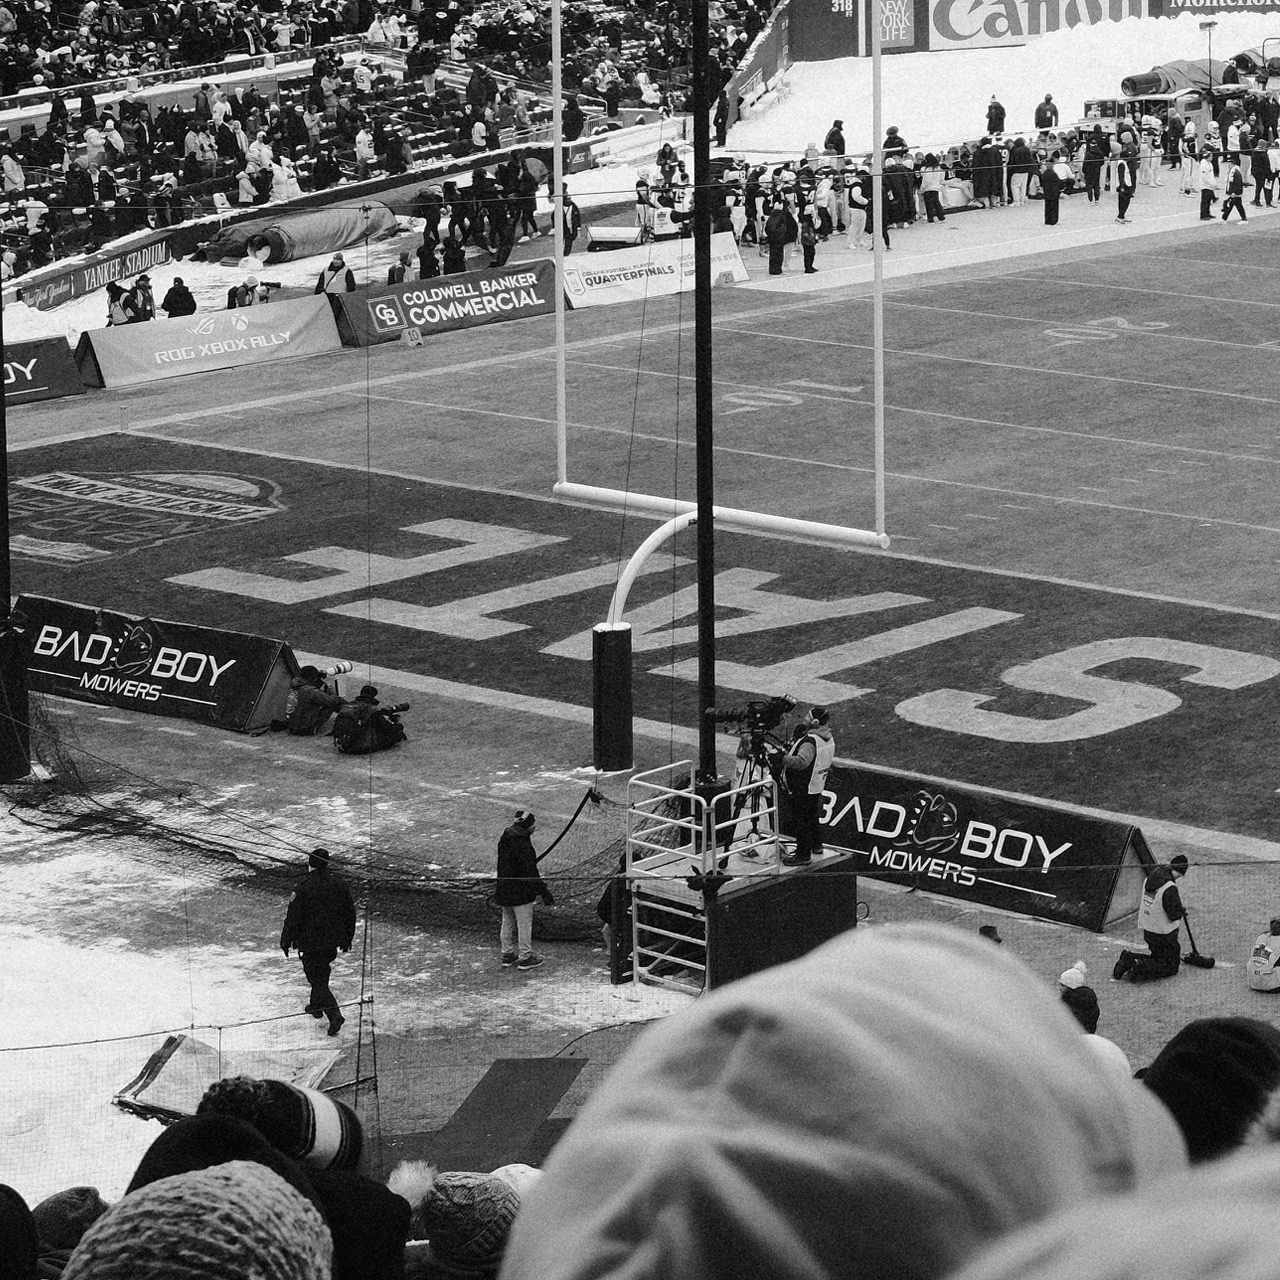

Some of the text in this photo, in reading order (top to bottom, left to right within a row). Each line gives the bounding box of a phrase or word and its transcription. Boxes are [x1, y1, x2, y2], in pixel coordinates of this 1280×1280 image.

[84, 241, 167, 291] YANKEE STADIUM
[585, 266, 675, 288] QUARTERFINALS
[402, 271, 538, 308] COLDWELL BANKER
[409, 289, 546, 326] COMMERCIAL
[154, 336, 248, 365] ROG XBOX
[34, 625, 237, 687] BAD BOY
[79, 672, 163, 702] MOWERS
[959, 819, 1073, 874] BOY
[868, 845, 978, 887] MOWERS
